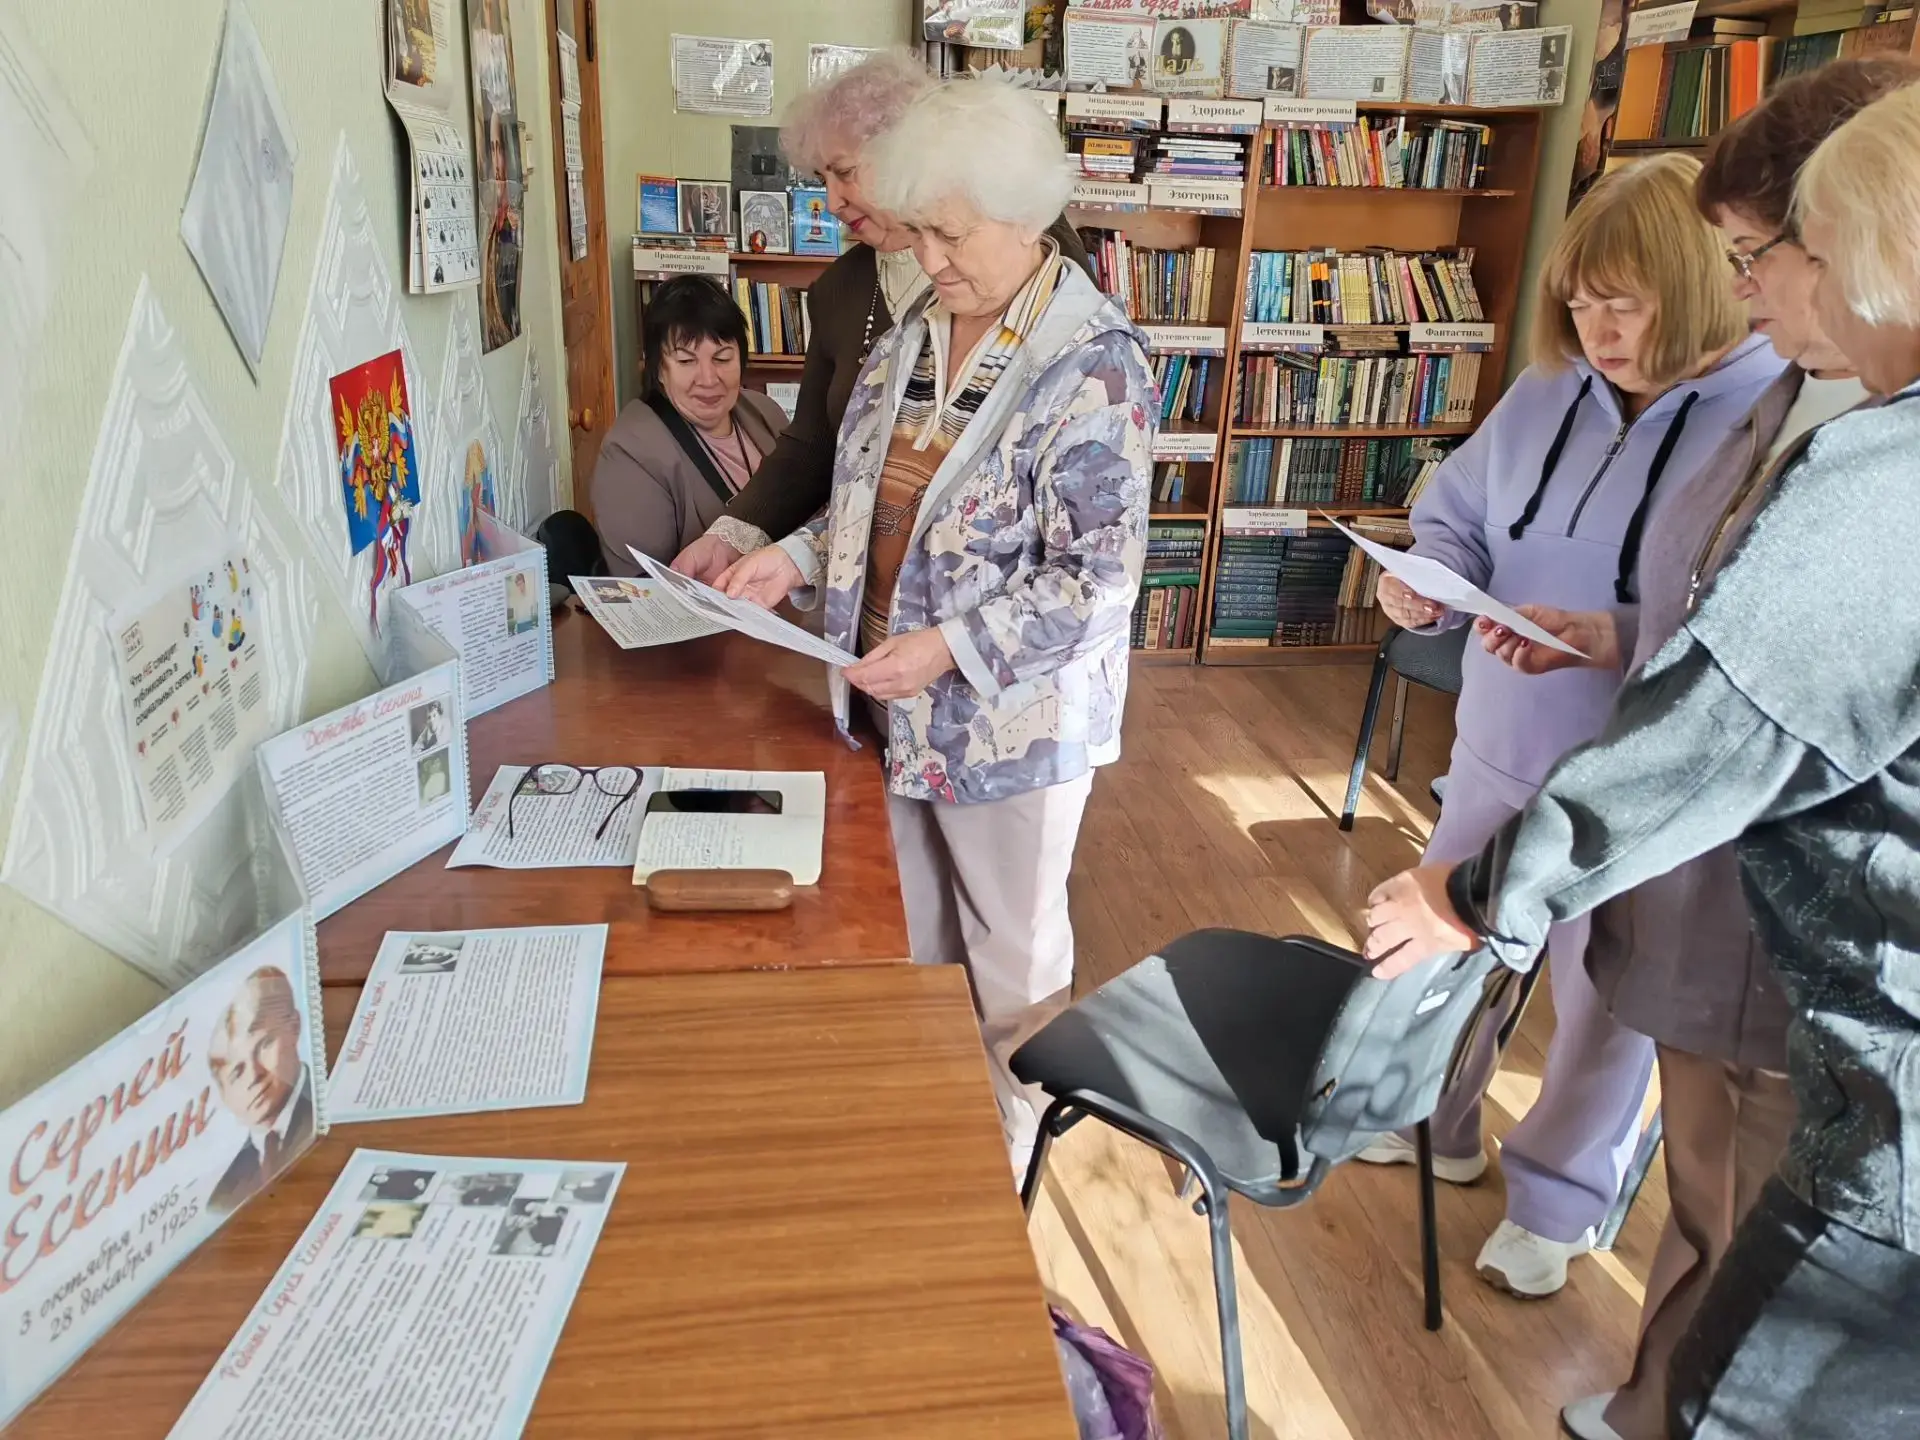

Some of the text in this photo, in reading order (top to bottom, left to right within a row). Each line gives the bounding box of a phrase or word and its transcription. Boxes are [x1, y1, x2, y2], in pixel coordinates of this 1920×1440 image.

[1309, 14, 1336, 25] 2026
[1189, 104, 1246, 118] Здоровье
[1273, 103, 1353, 116] Женские романы
[1073, 184, 1136, 199] Кулинария
[1168, 189, 1230, 203] Эзотерика
[654, 251, 712, 262] Православная
[659, 262, 706, 272] литература
[1153, 331, 1212, 343] Путешествие
[1252, 326, 1311, 338] Детективы
[1425, 326, 1484, 338] Фантастика
[303, 686, 423, 751] Детство Есенина
[8, 1017, 191, 1196] Сергей
[0, 1085, 216, 1294] Есенин
[19, 1310, 33, 1337] 3
[40, 1230, 130, 1318] октября
[139, 1184, 180, 1234] 1895
[50, 1197, 199, 1343] 28 декабря 1925
[219, 1212, 343, 1380] Родные Сергея Есенина
